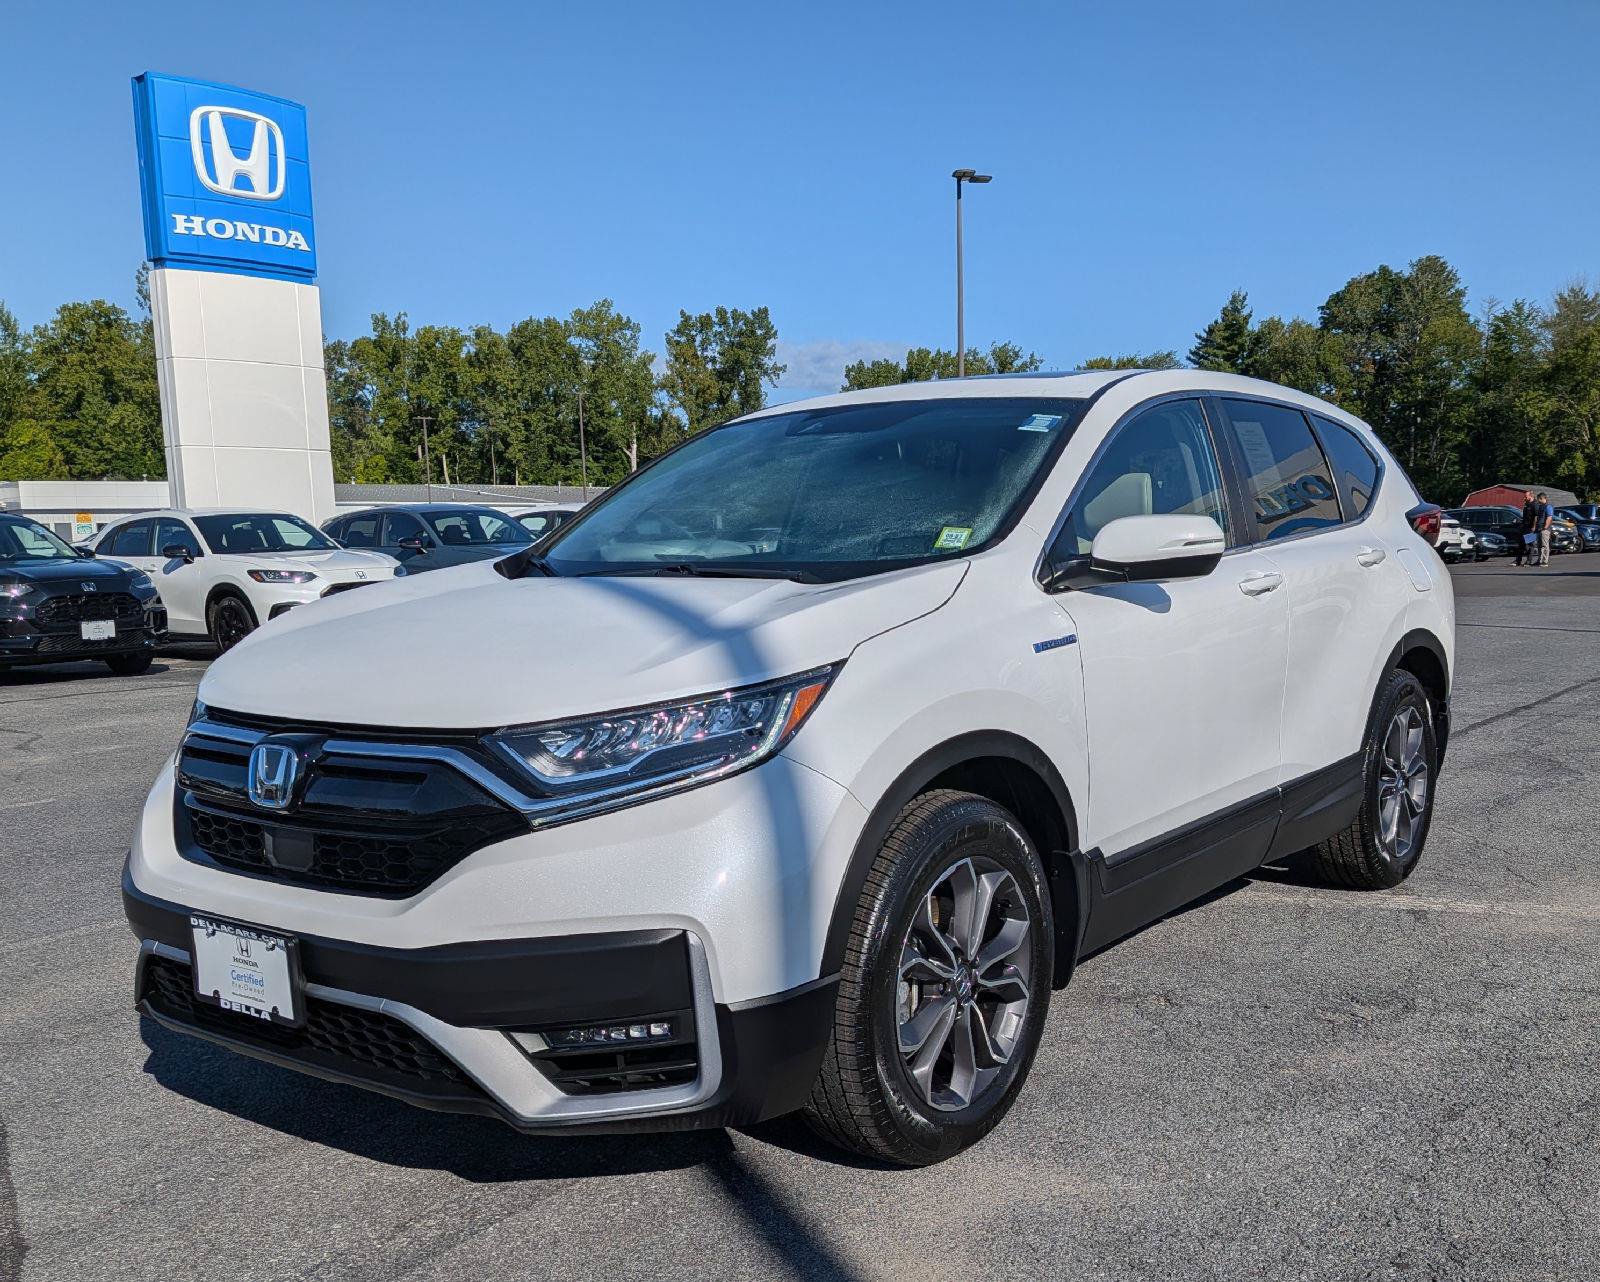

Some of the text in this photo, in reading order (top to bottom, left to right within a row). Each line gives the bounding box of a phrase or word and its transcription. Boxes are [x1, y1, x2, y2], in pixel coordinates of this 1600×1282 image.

[171, 213, 311, 251] HONDA
[232, 956, 259, 968] HONDA
[231, 969, 264, 987] Certified
[220, 999, 272, 1021] DELLA
